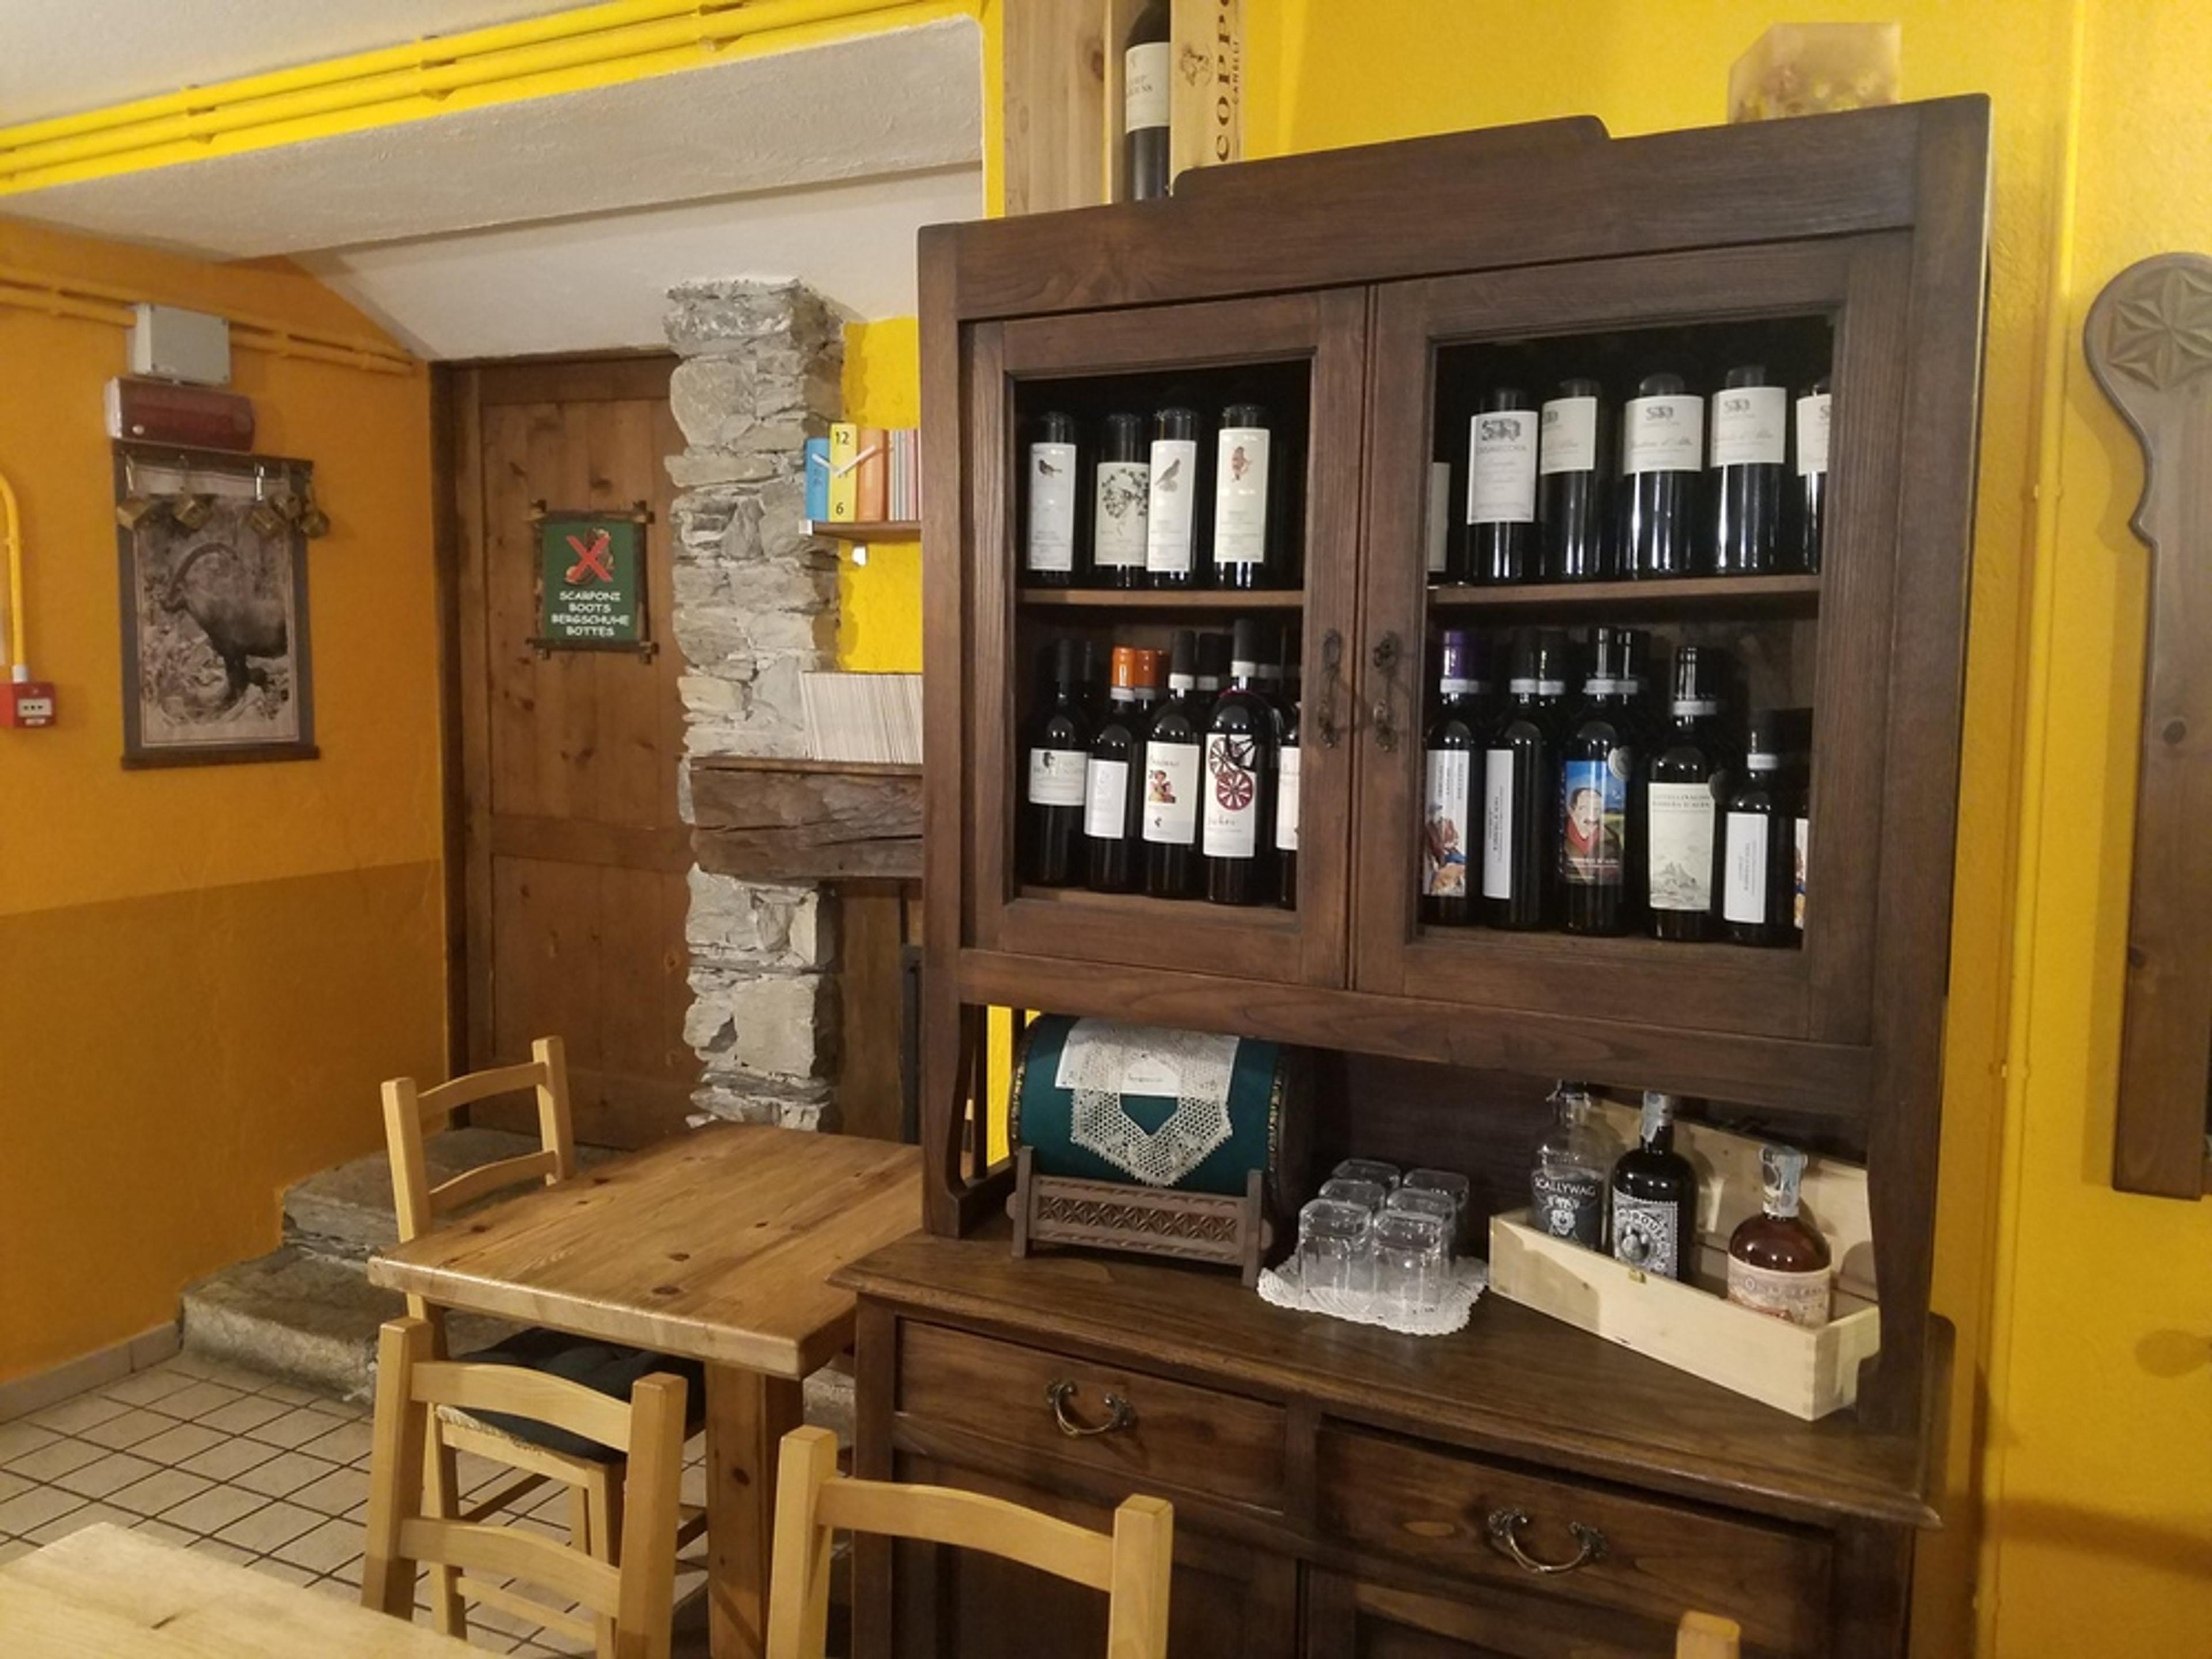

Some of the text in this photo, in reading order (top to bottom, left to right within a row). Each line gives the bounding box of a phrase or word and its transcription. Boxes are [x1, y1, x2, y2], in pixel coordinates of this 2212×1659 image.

[1216, 0, 1231, 162] COPP
[835, 431, 850, 445] 12
[835, 502, 844, 515] 6
[568, 603, 612, 613] BOOTS
[551, 613, 630, 626] BERGSCHUHE
[566, 626, 615, 638] BOTTES
[1533, 1176, 1596, 1198] SCALLYWAG
